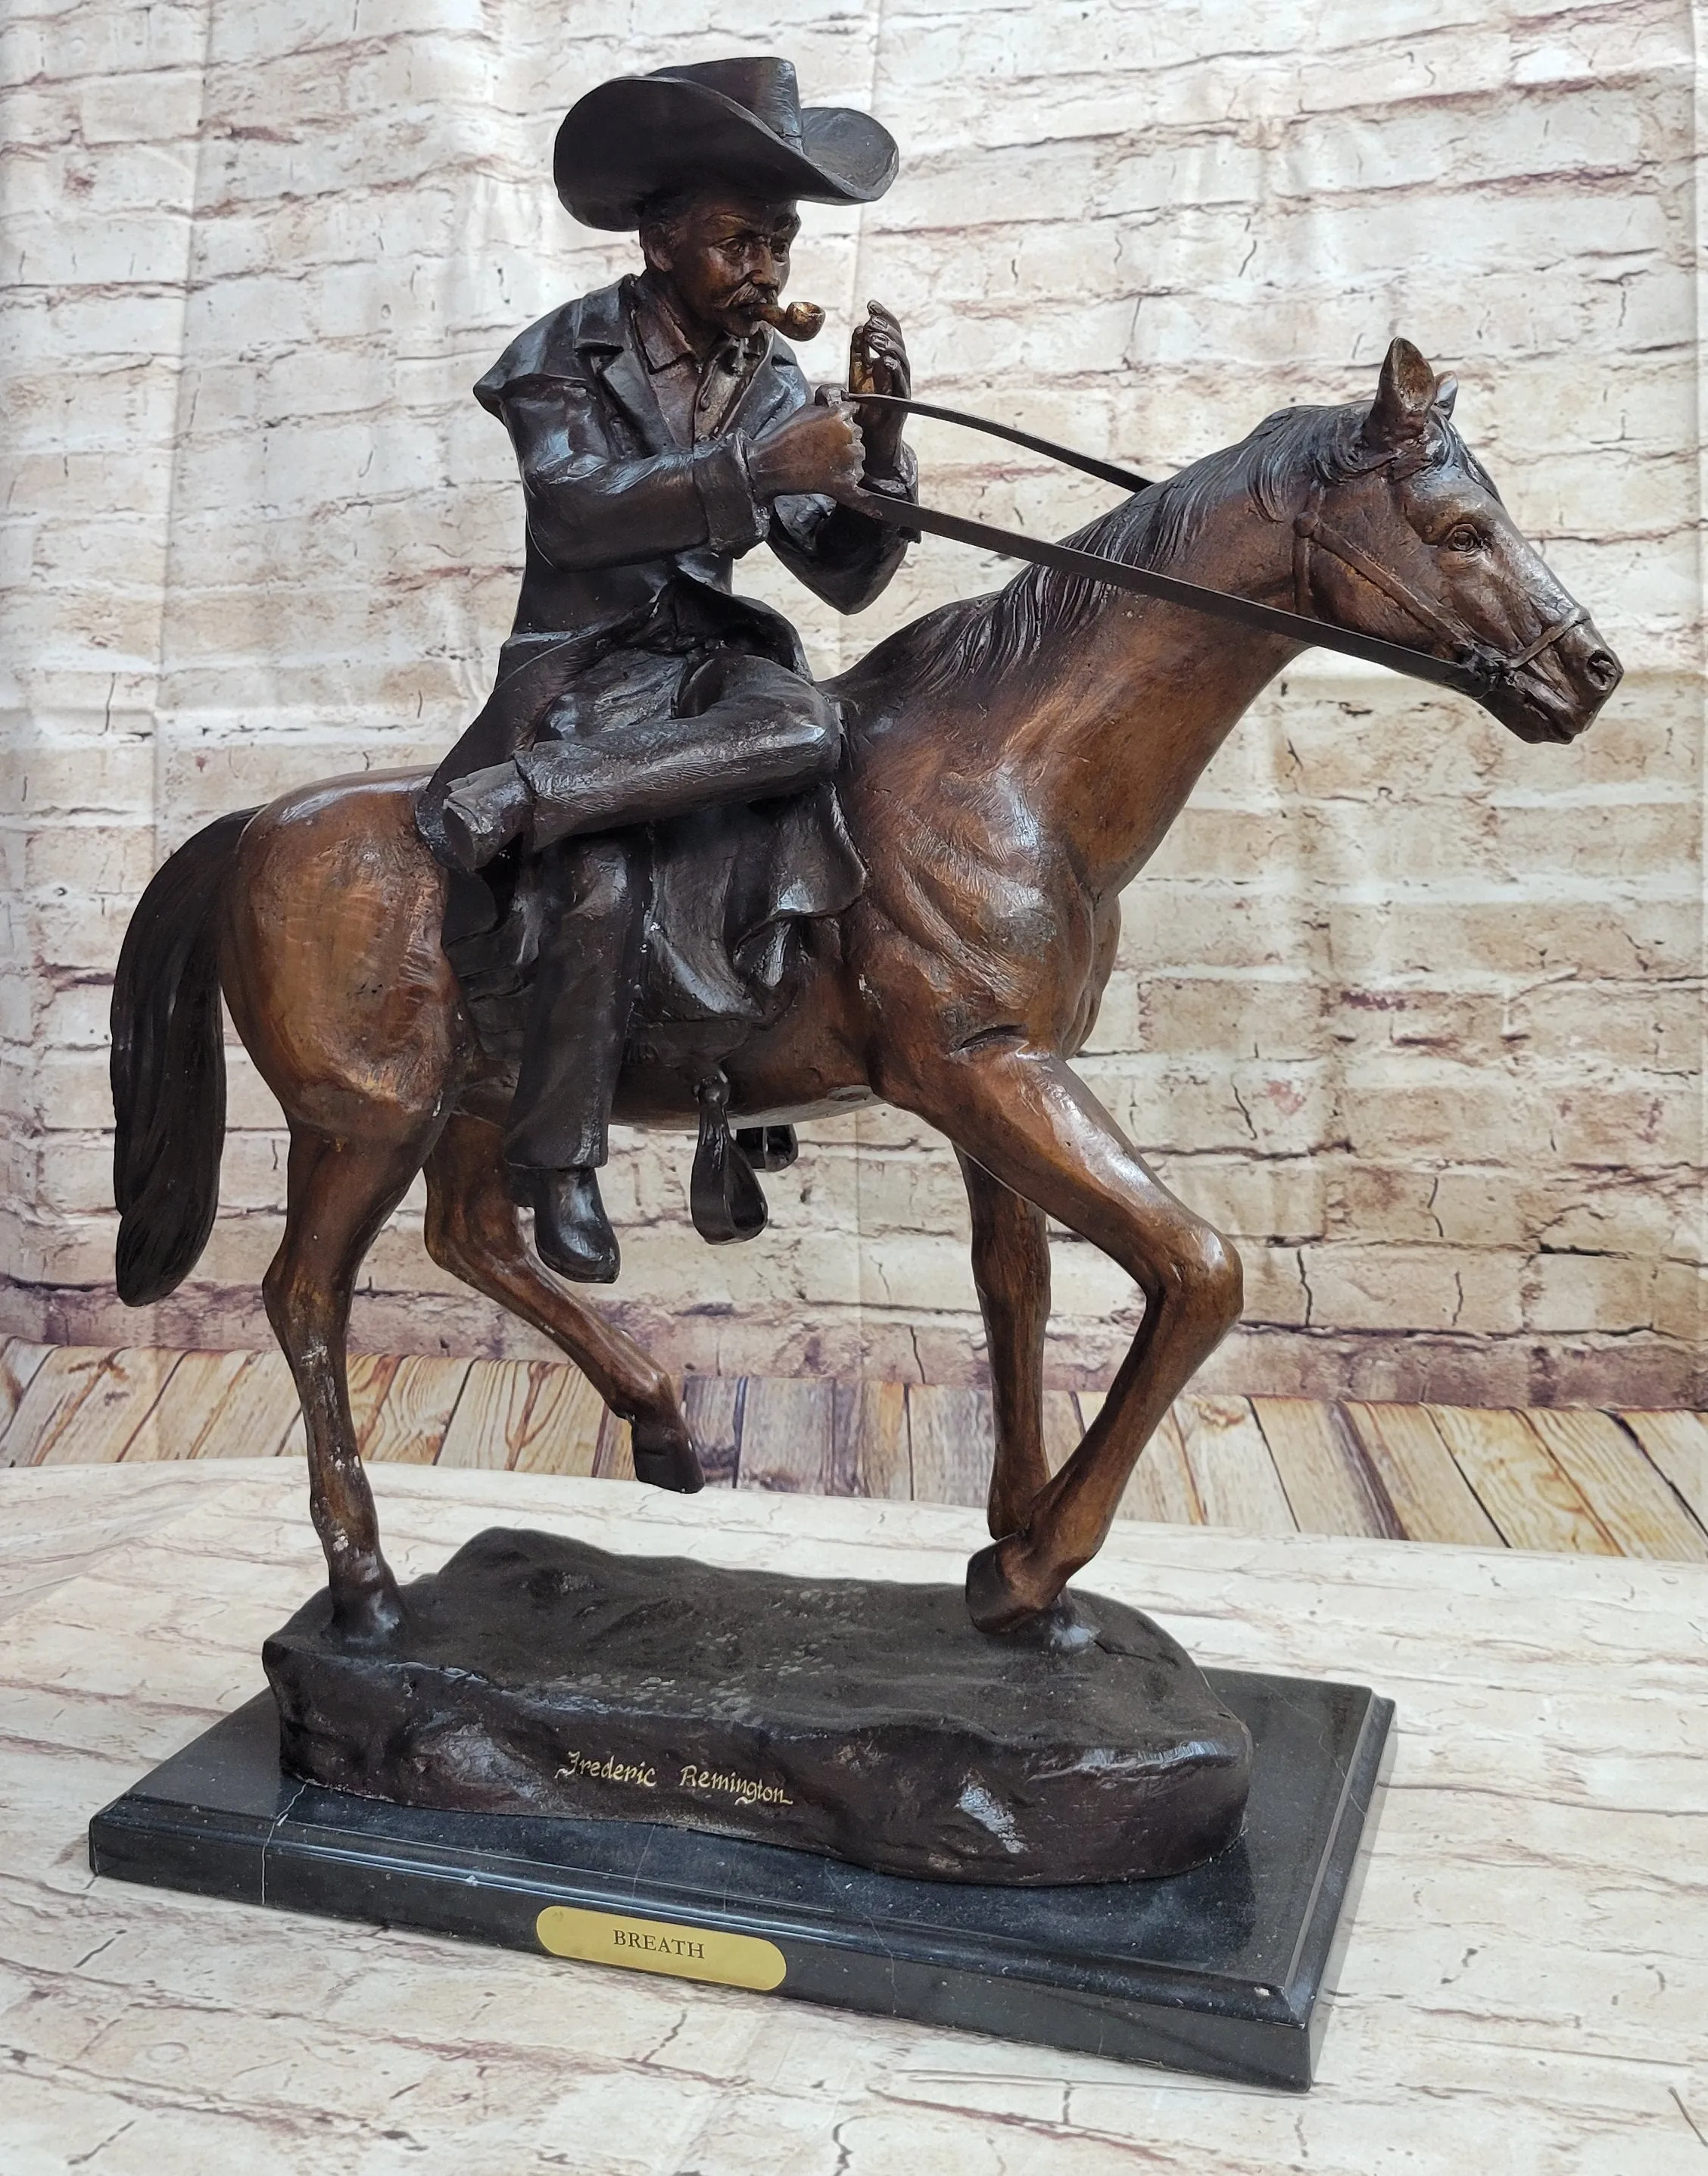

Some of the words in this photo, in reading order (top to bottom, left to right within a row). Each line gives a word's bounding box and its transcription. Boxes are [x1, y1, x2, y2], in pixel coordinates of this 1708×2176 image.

[554, 1750, 658, 1788] Frederic
[679, 1764, 793, 1806] Remington
[612, 1929, 705, 1959] BREATH
